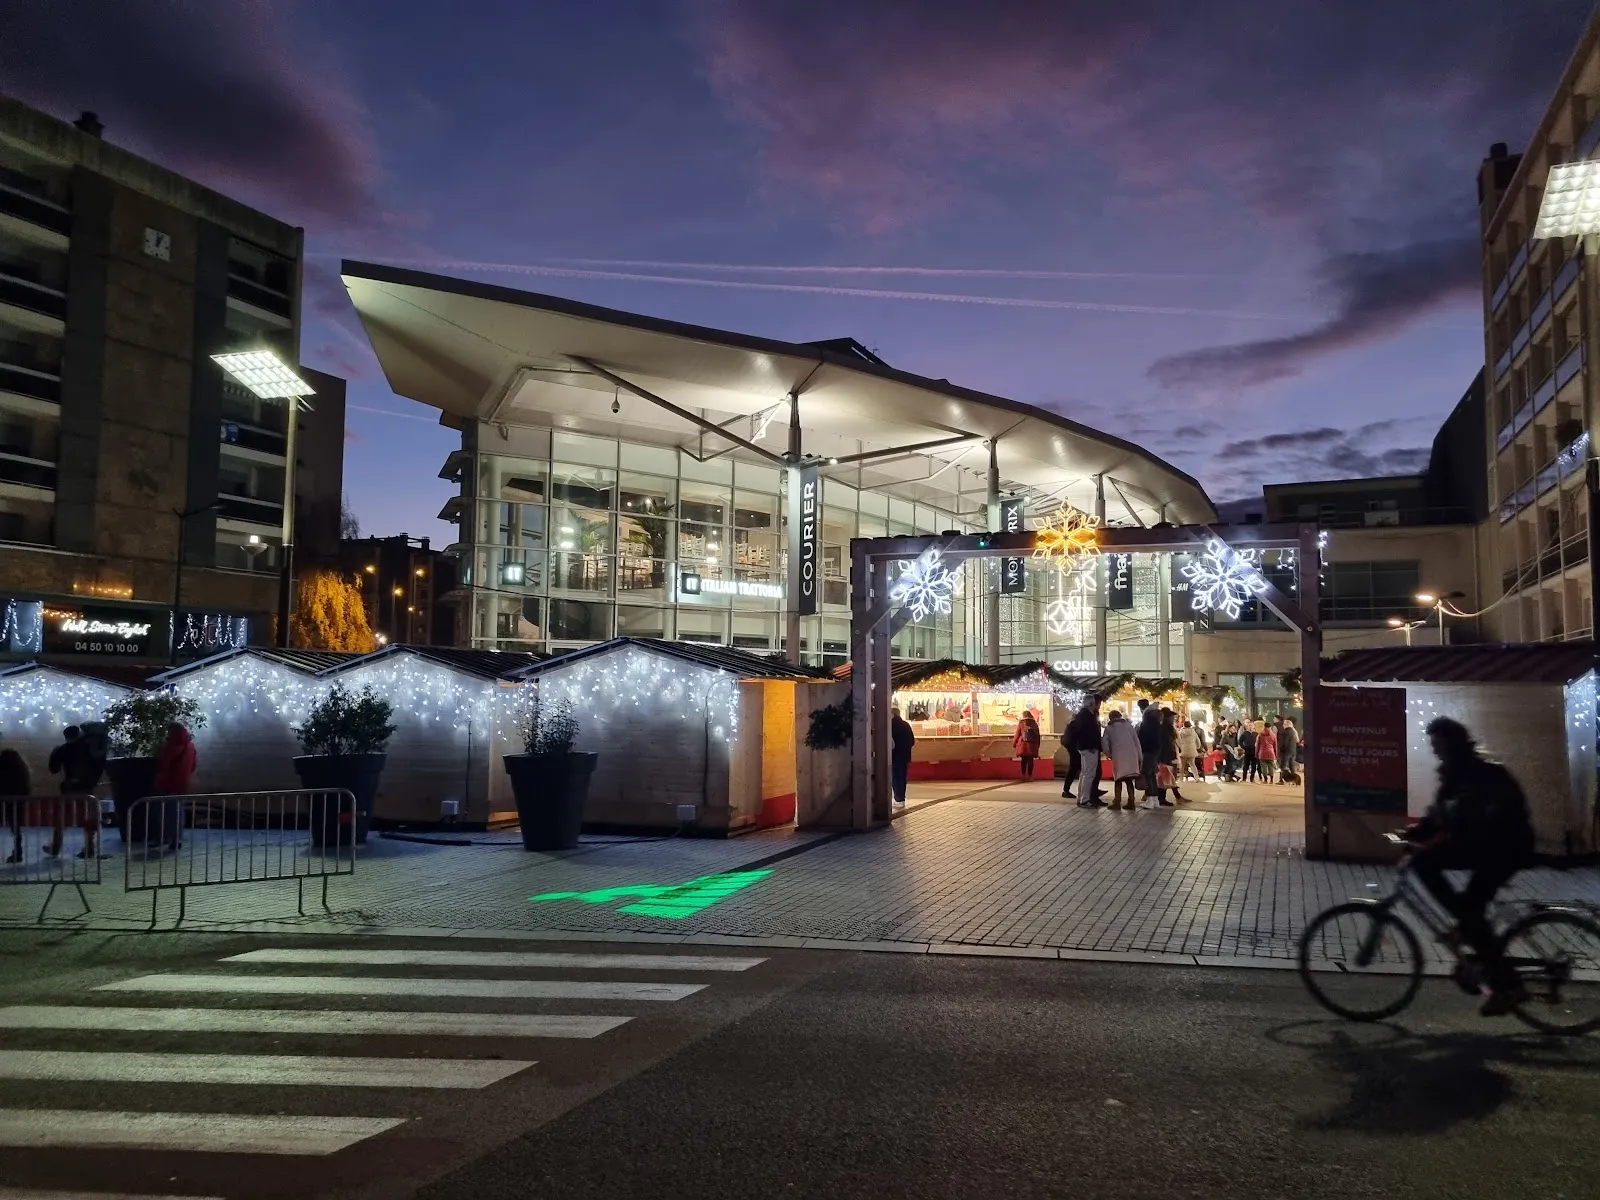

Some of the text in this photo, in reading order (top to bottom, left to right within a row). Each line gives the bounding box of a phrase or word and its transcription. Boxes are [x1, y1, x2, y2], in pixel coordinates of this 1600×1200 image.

[803, 481, 814, 596] COURIER
[701, 579, 738, 595] ITALIAN
[738, 582, 783, 599] TRATTORIA
[62, 619, 88, 634] Wall
[117, 622, 150, 639] English
[75, 641, 139, 653] 04 50 10 10 00
[1332, 725, 1388, 736] BIENVENUE
[1320, 746, 1399, 761] TOUS LES JOURS
